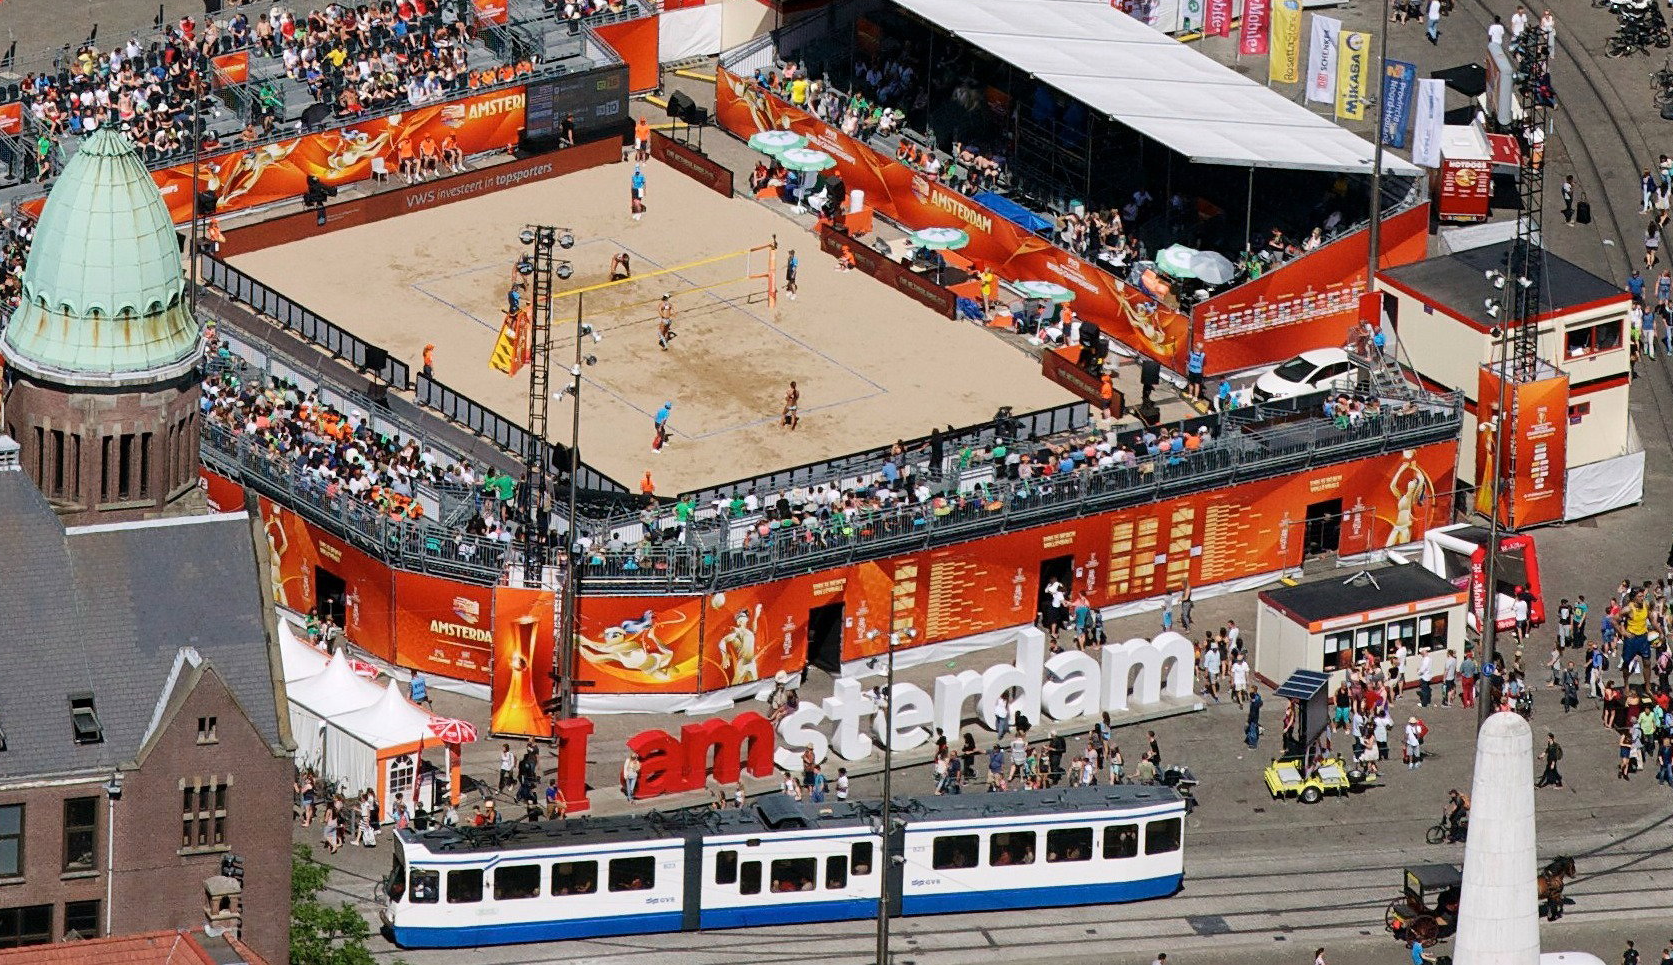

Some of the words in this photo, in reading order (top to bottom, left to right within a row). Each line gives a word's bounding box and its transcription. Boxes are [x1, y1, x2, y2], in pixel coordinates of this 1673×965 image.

[1346, 54, 1361, 115] MIKASA
[1394, 81, 1407, 125] Provincie
[406, 191, 435, 209] VWS
[437, 179, 482, 200] investeert
[484, 176, 494, 190] in
[496, 163, 553, 186] topsporters
[931, 190, 992, 236] AMSTERDAM
[556, 717, 594, 812] I
[623, 626, 1195, 800] amsterdam
